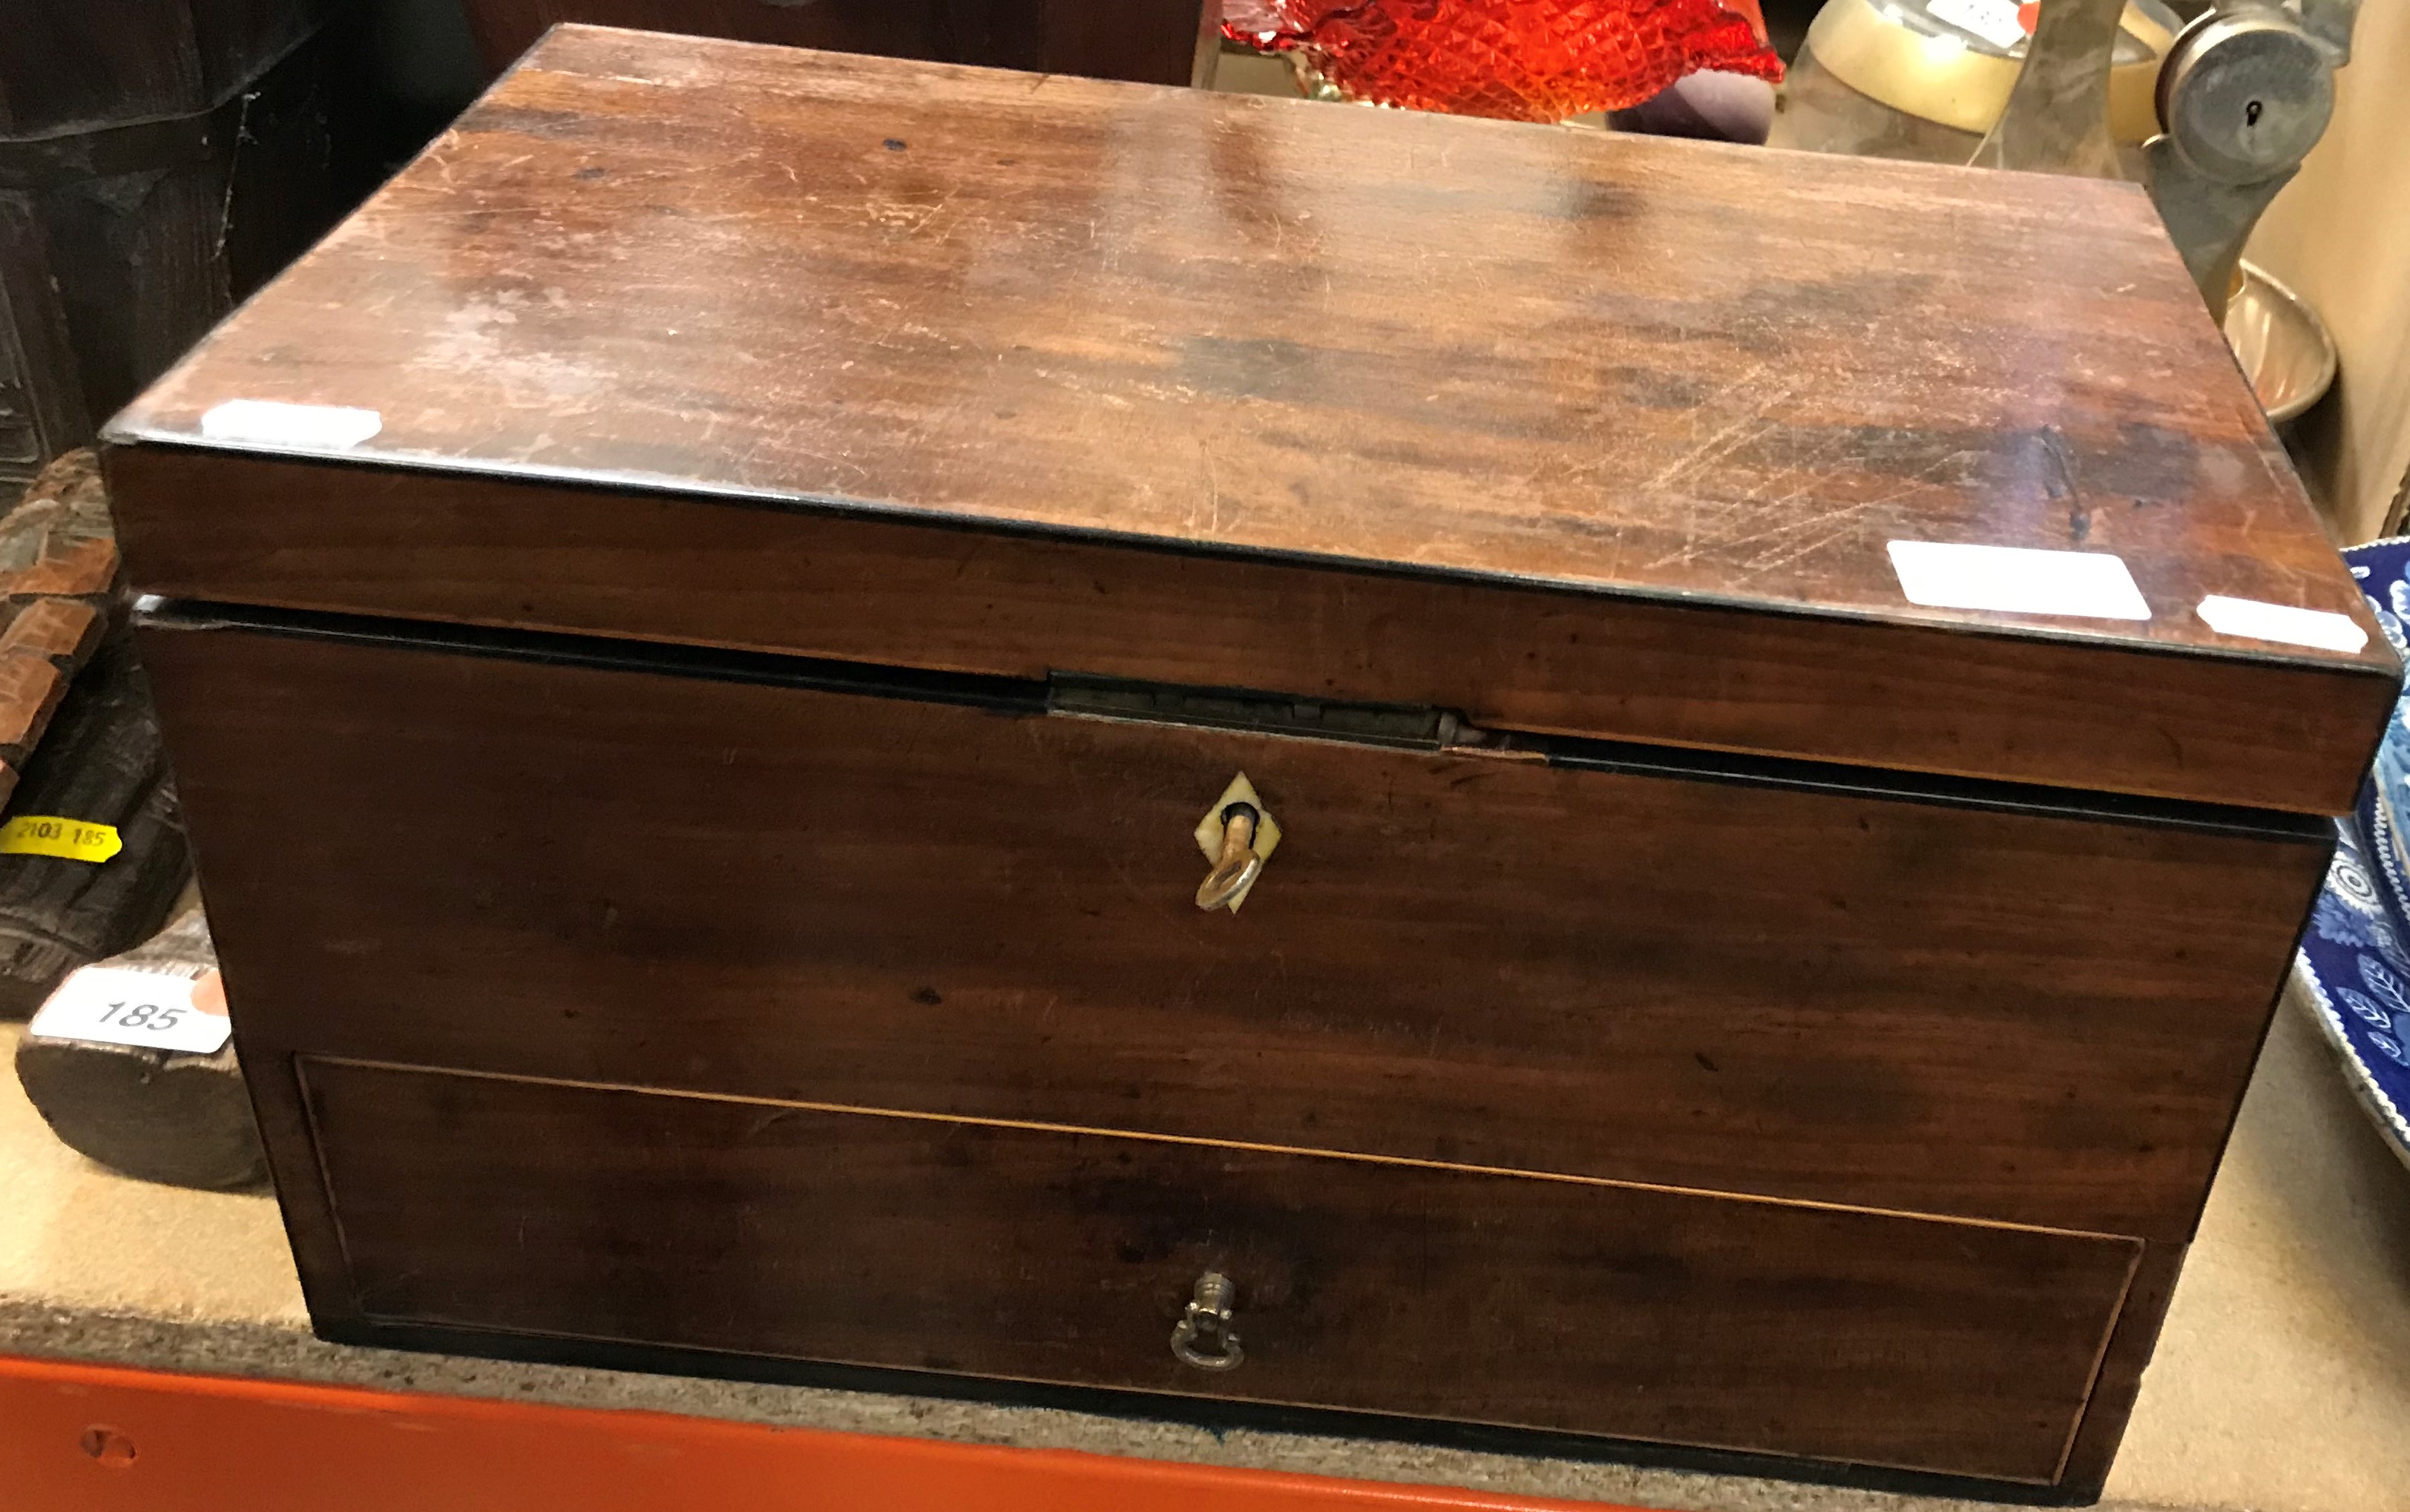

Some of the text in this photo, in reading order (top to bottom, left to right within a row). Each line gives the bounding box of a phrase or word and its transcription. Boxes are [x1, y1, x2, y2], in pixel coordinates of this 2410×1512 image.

[17, 821, 106, 846] 2103 185
[99, 1001, 188, 1031] 185
